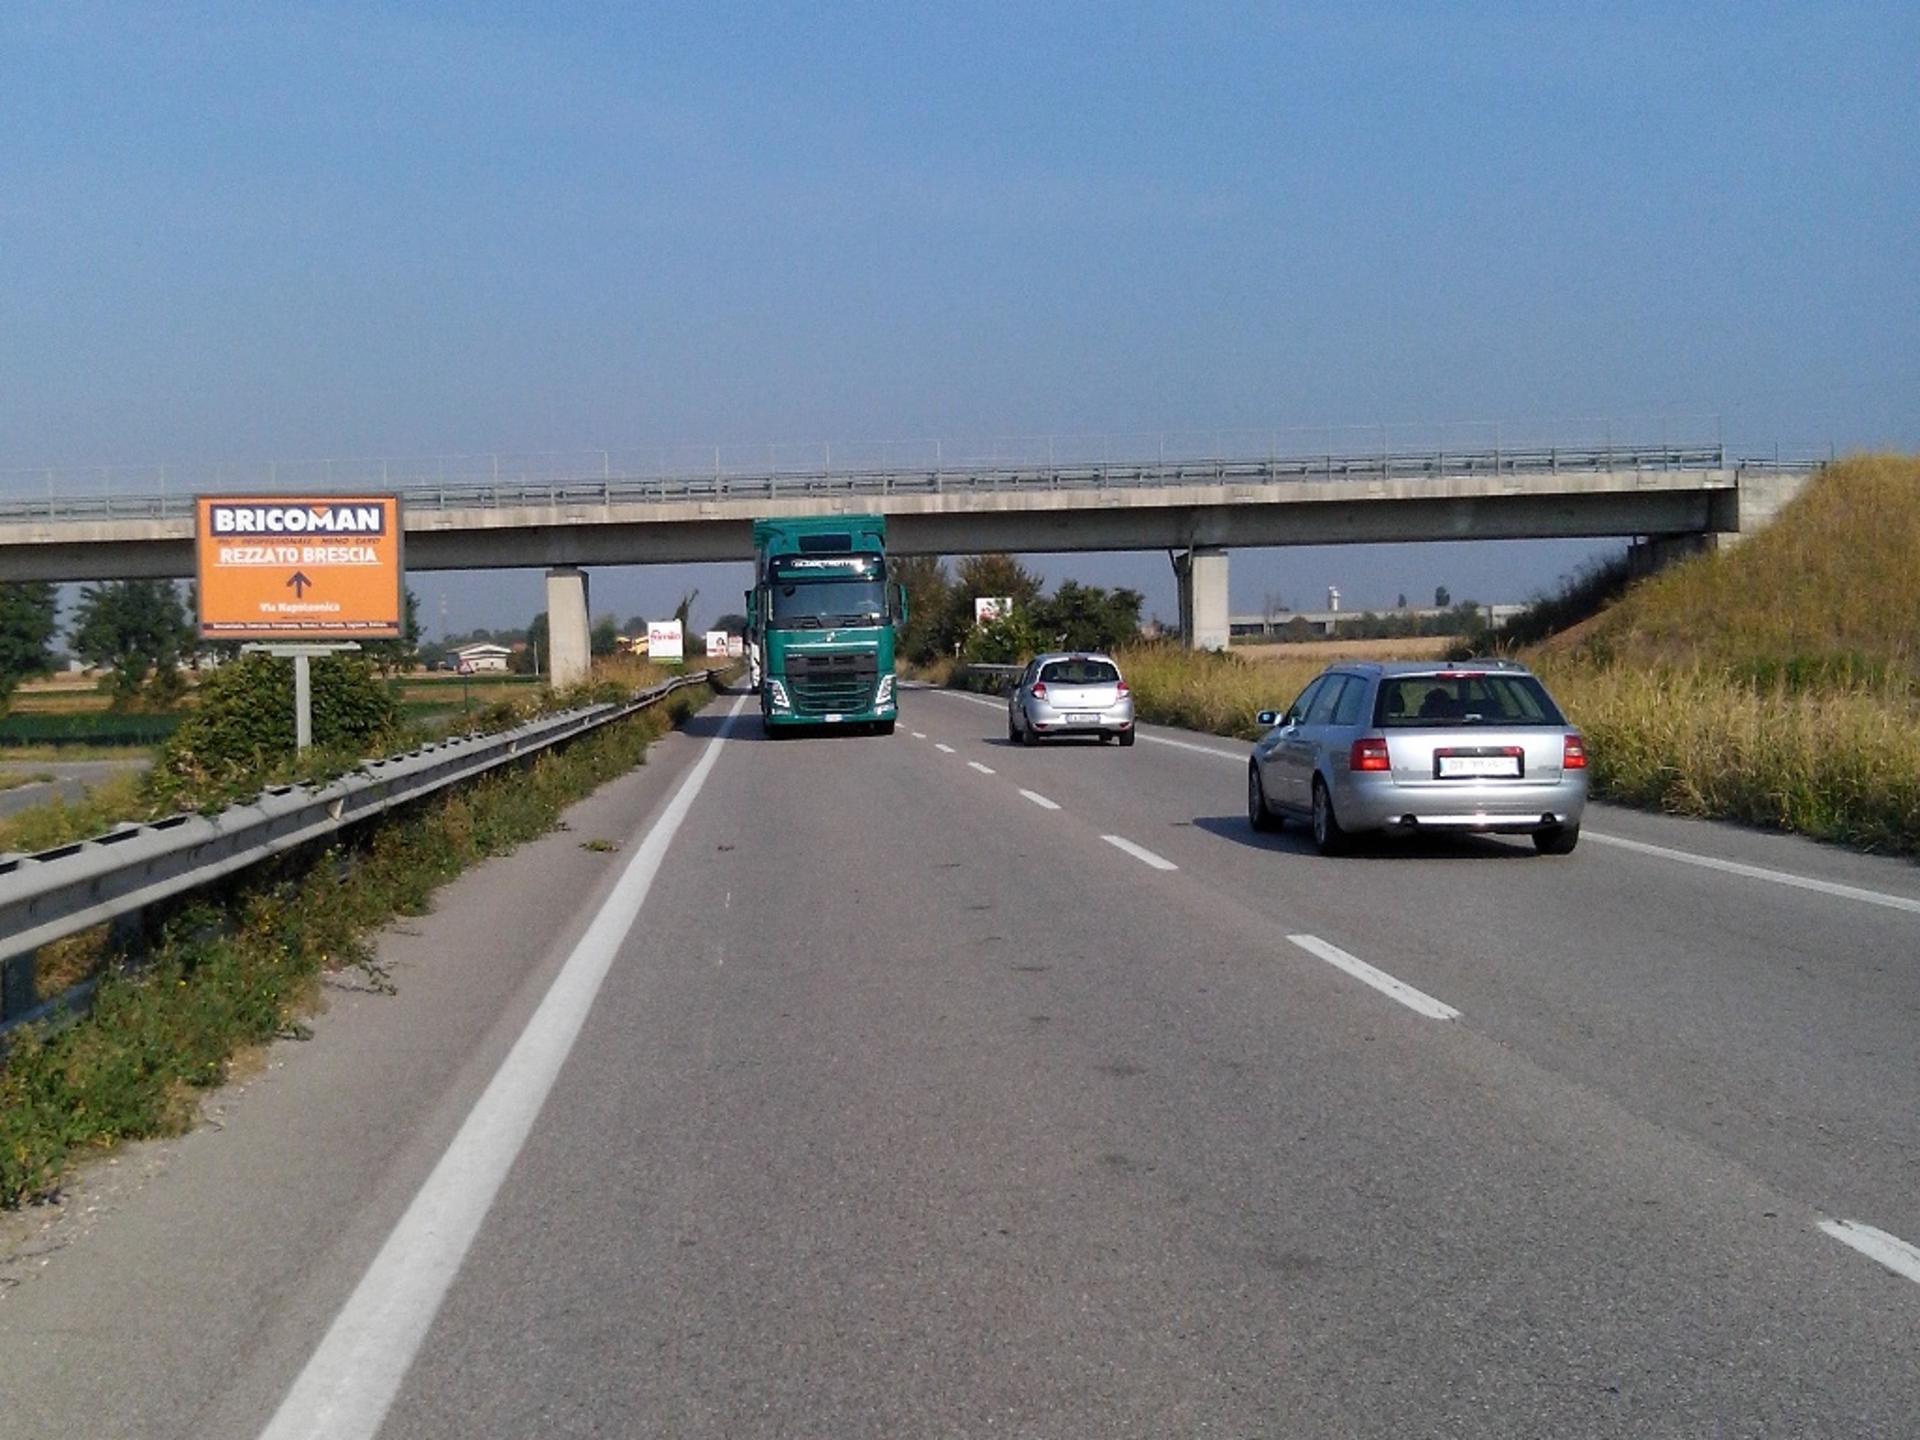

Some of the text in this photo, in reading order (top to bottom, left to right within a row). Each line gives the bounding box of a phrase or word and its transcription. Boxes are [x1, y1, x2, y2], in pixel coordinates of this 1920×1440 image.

[215, 507, 380, 532] BRICOMAN
[220, 546, 378, 564] REZZATO BRESCIA
